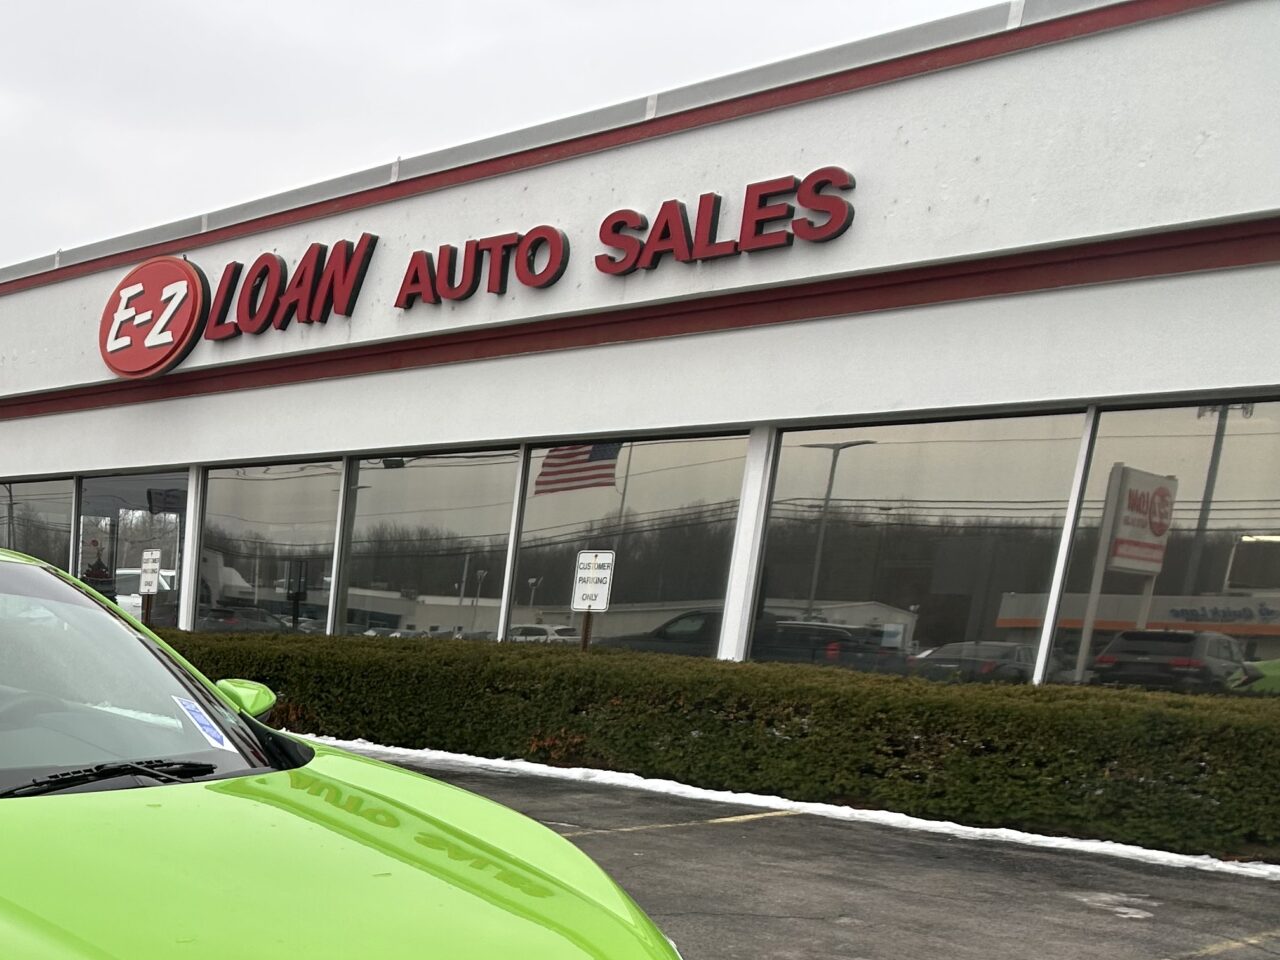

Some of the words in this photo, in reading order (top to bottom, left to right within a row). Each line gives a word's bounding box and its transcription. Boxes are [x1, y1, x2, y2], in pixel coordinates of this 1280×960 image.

[105, 280, 190, 353] E-Z
[204, 231, 379, 342] LOAN
[394, 225, 569, 310] AUTO
[595, 164, 857, 276] SALES
[579, 562, 611, 570] CUSTOMER
[578, 576, 608, 585] PARKING
[582, 593, 598, 601] ONLY
